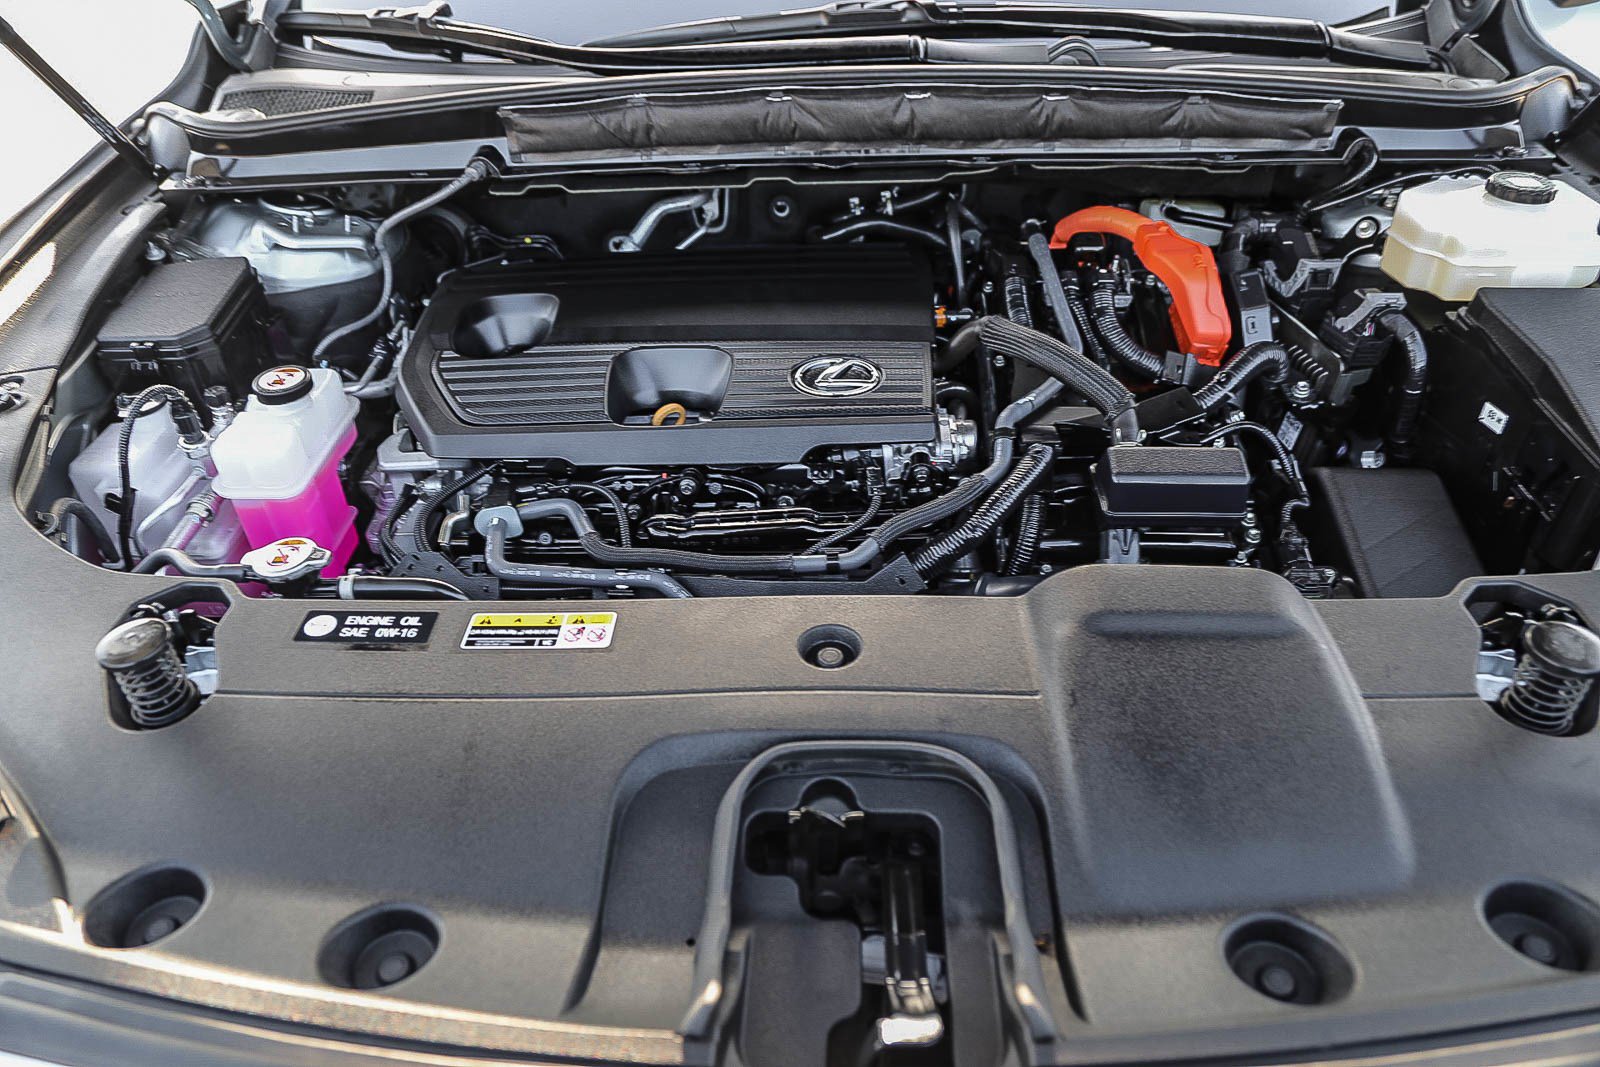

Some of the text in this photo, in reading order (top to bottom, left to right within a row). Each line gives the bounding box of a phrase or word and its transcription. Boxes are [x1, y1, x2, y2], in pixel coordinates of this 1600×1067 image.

[344, 615, 422, 626] ENGINE OIL
[338, 627, 418, 638] SAE 0W-16
